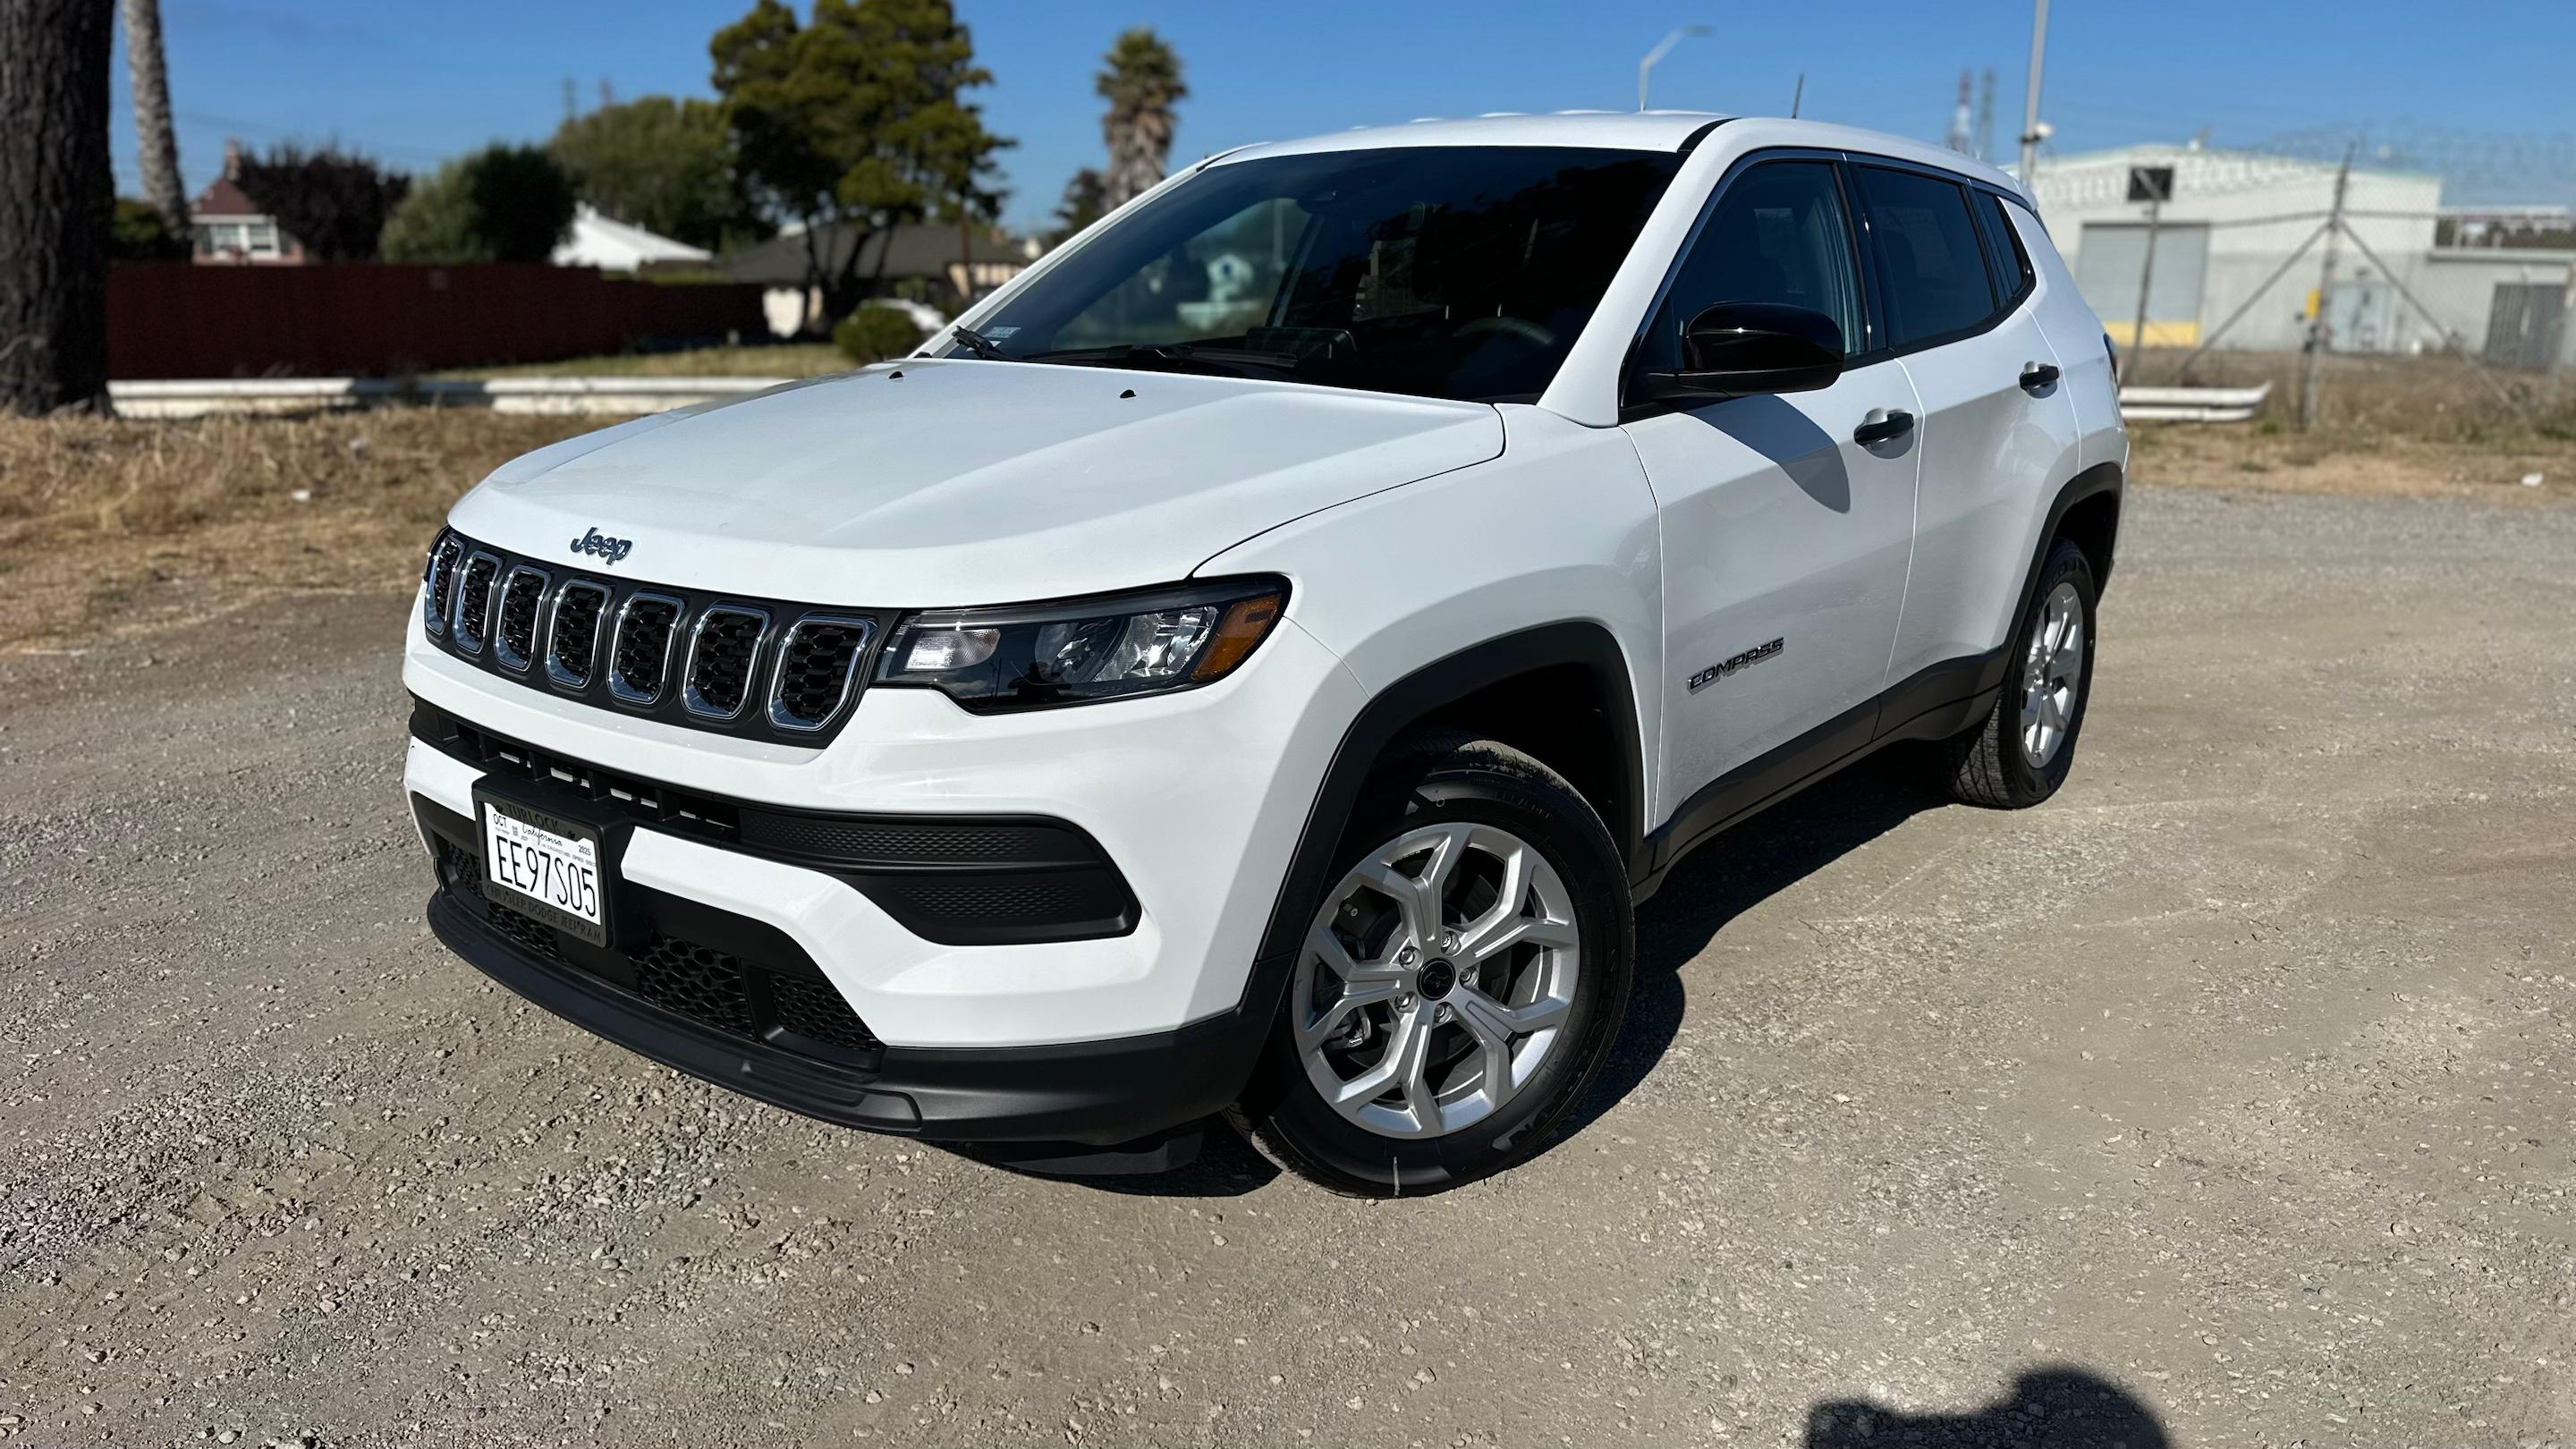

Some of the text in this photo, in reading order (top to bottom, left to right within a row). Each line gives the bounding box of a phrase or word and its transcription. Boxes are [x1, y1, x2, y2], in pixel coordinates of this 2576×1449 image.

[571, 527, 632, 565] Jeep
[1687, 637, 1784, 692] COMPASS
[494, 814, 507, 828] OCT
[507, 804, 560, 833] TURLOCK
[496, 835, 596, 917] EE97S05
[487, 885, 601, 941] CHRYSLER DODGE JEEP RAM
